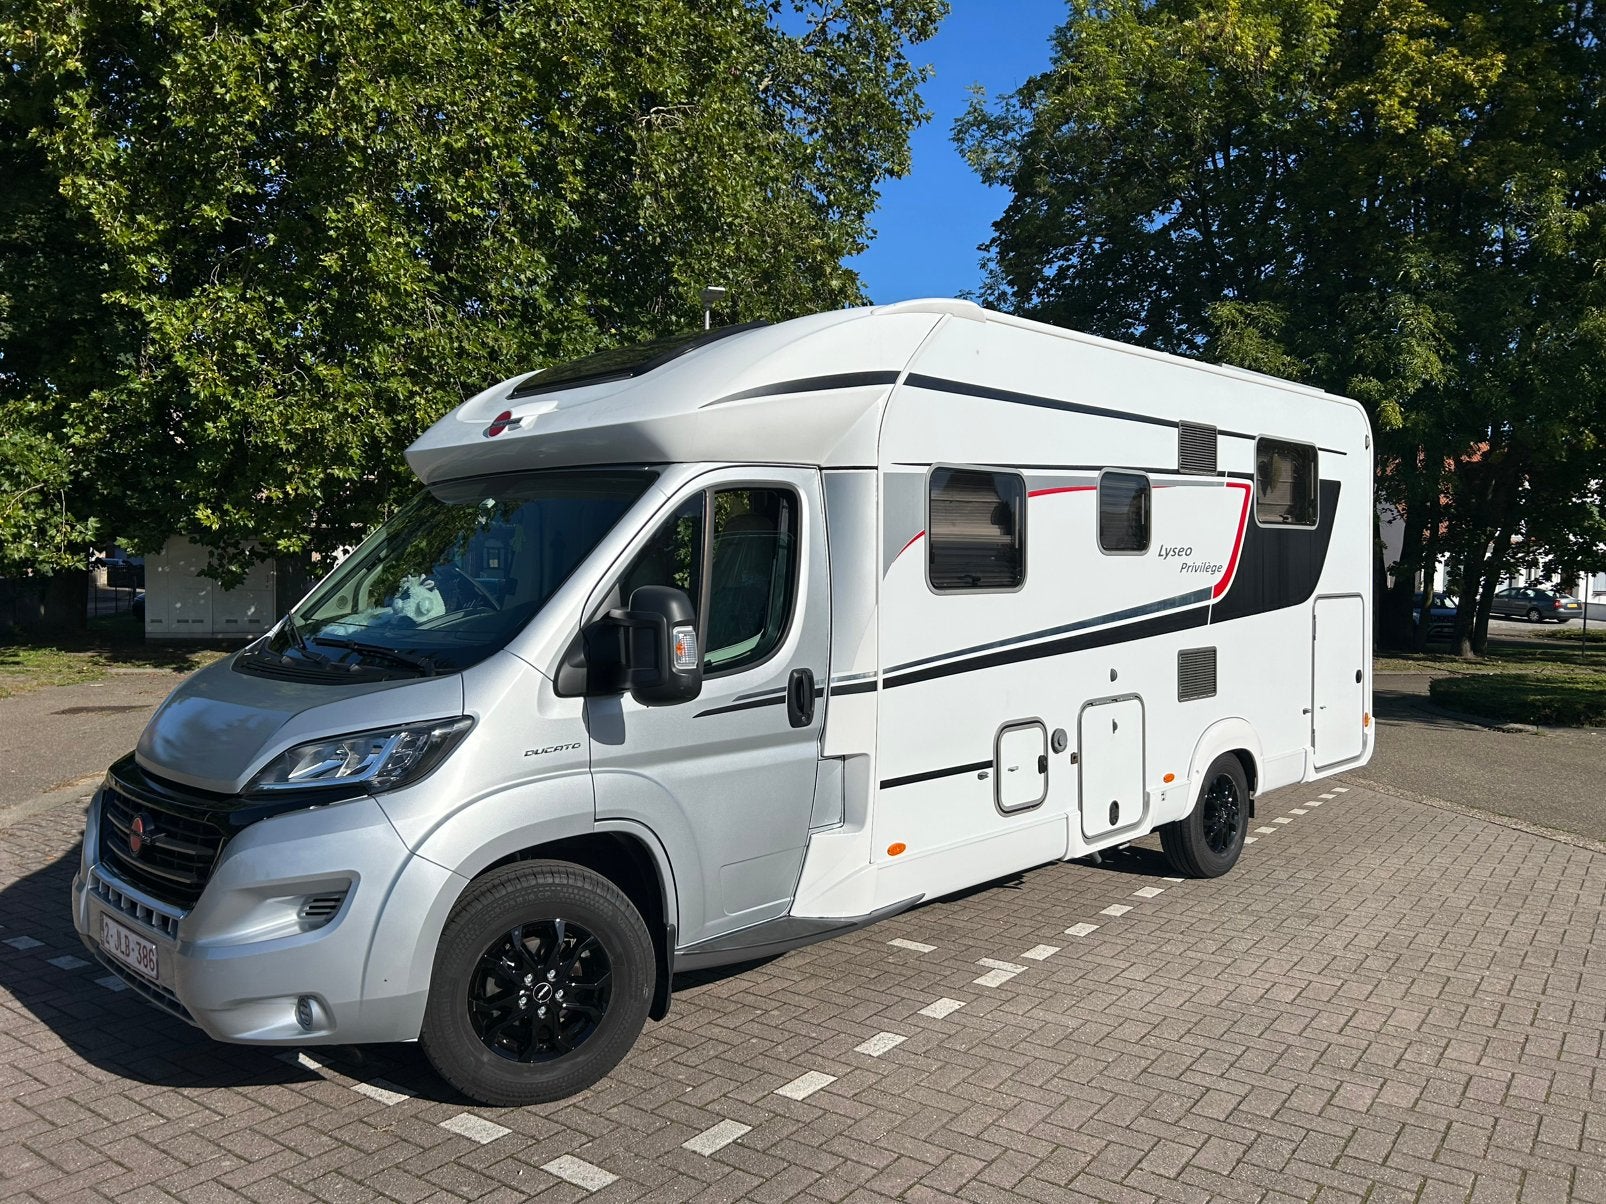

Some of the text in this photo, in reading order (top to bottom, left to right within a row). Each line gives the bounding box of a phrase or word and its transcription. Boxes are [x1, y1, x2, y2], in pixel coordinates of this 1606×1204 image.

[1158, 544, 1193, 560] Lyseo
[1180, 561, 1223, 575] Privilège
[524, 742, 581, 757] DUCATO
